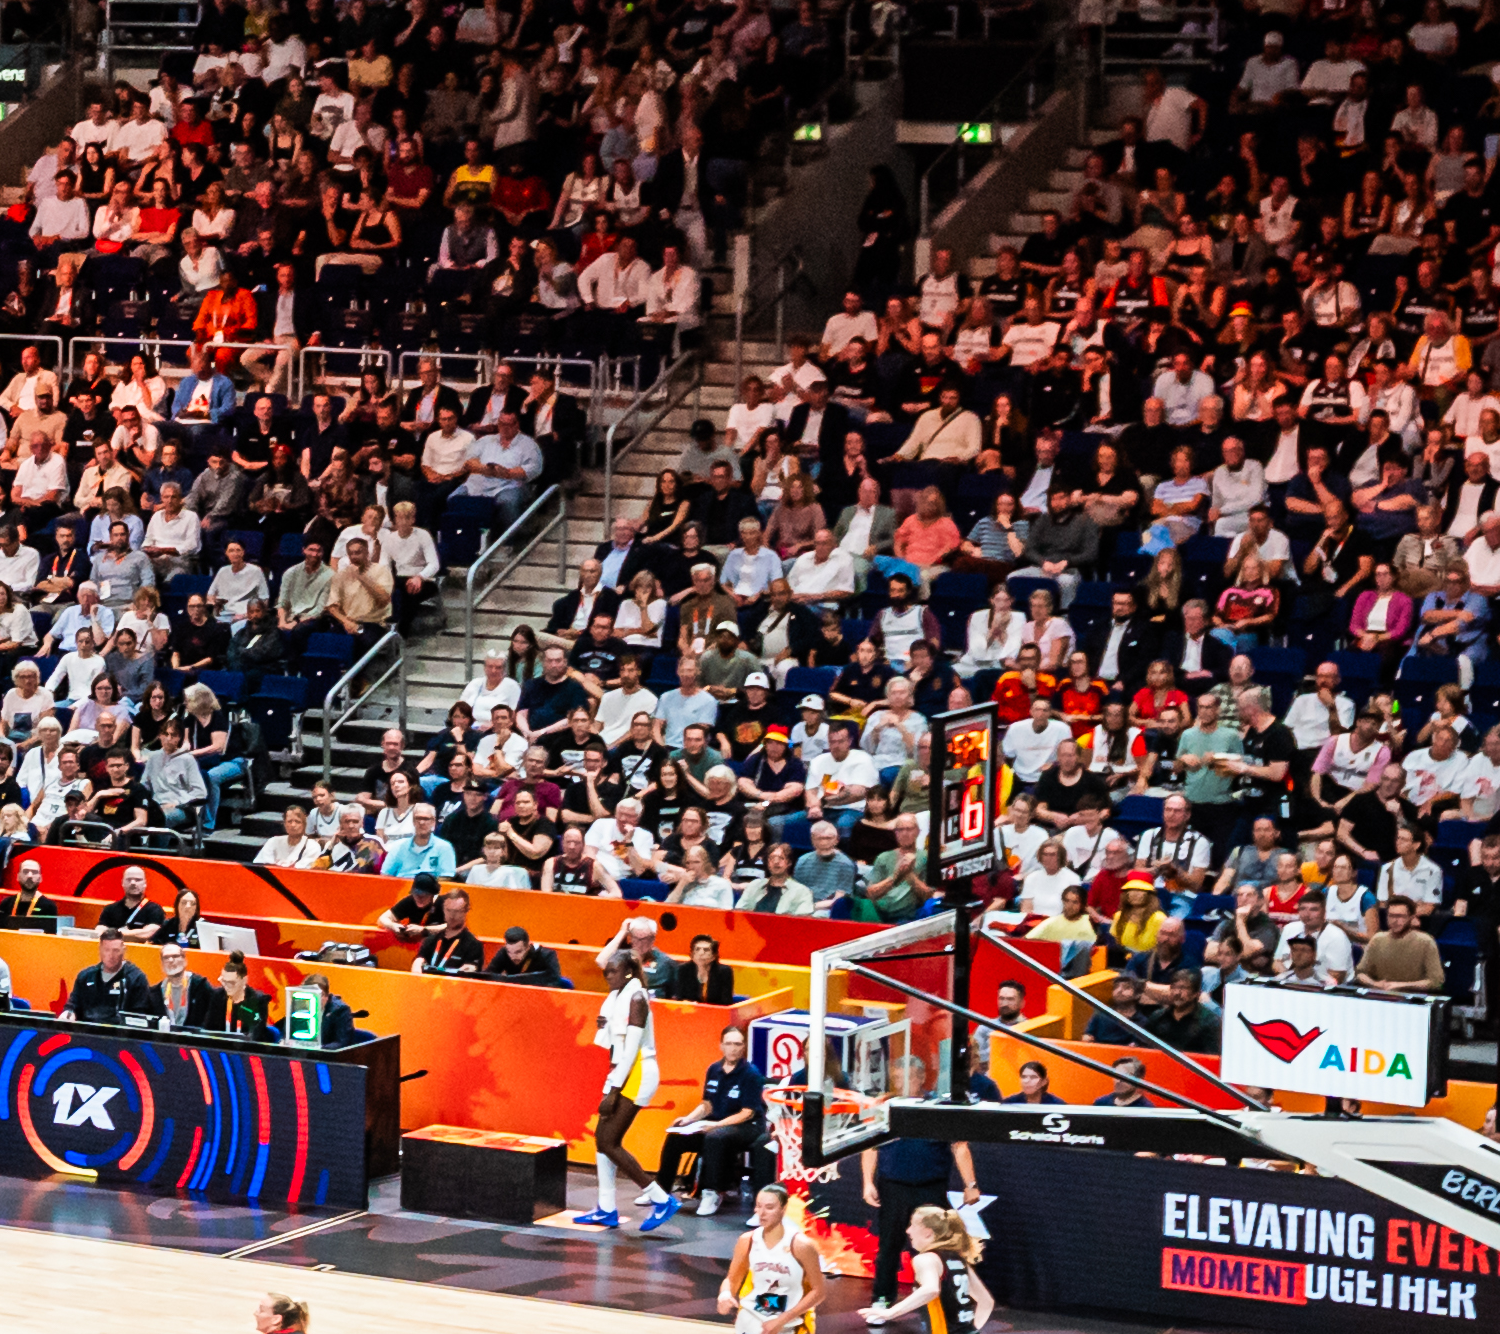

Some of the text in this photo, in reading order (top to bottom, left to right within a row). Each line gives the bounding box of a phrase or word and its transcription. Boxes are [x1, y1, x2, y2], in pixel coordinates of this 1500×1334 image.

[961, 777, 986, 840] 6
[292, 990, 319, 1039] 3
[1318, 1044, 1413, 1080] AIDA
[52, 1082, 120, 1131] 1X
[1062, 1133, 1106, 1146] Sports
[1162, 1191, 1500, 1276] ELEVATING EVER
[1170, 1253, 1299, 1298] MOMENT
